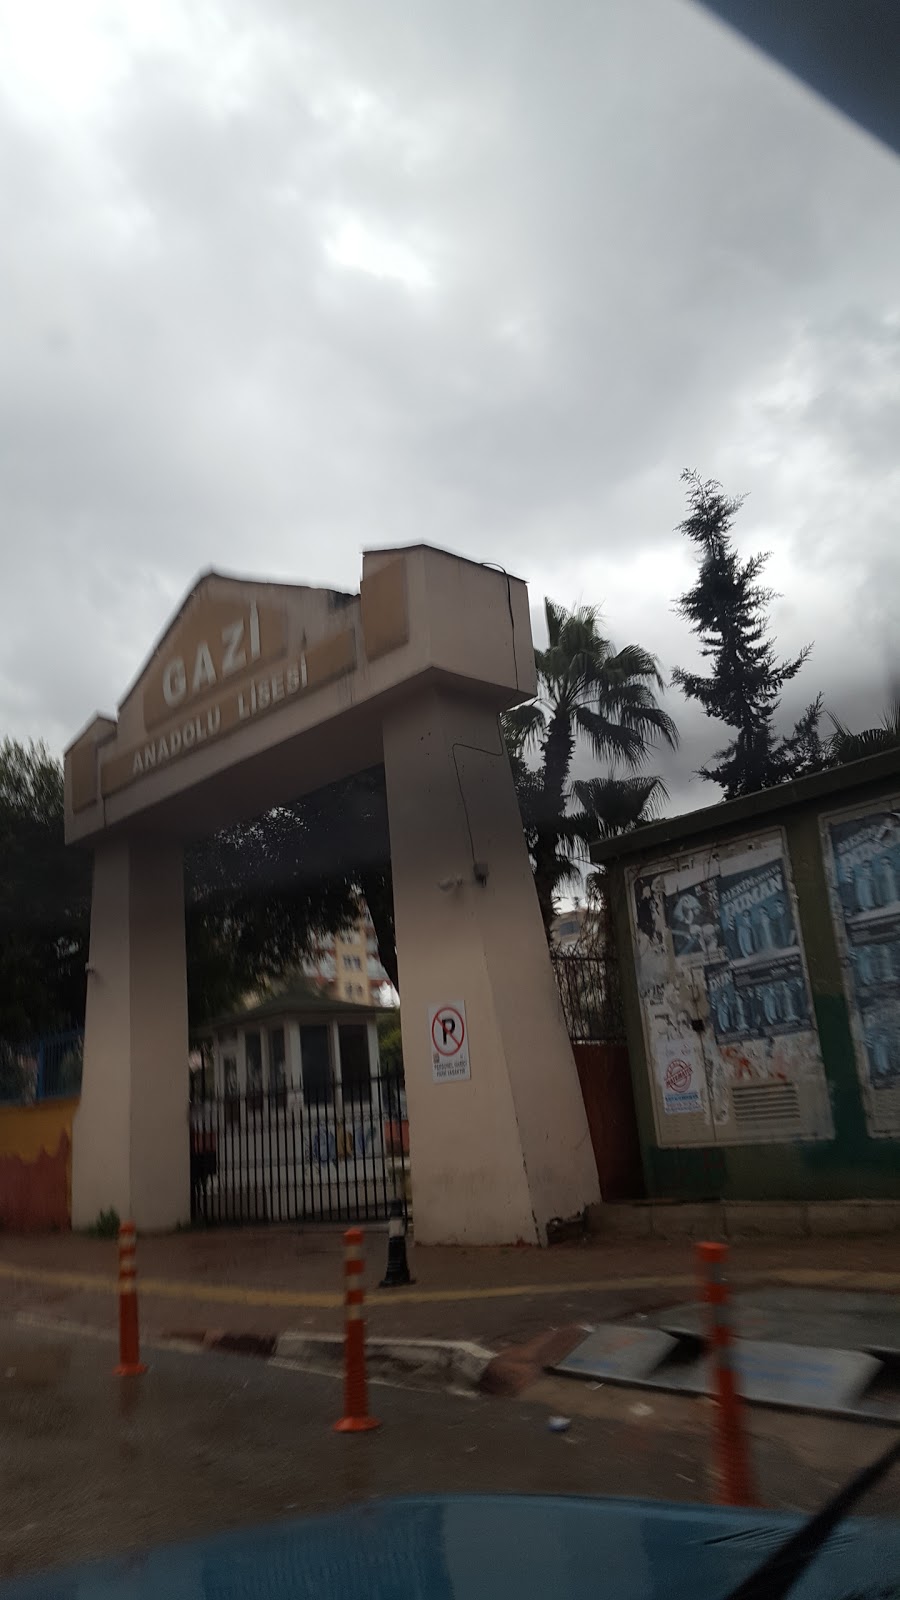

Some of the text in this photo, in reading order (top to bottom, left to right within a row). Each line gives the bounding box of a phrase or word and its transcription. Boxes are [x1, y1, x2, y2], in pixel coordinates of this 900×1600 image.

[162, 599, 261, 708] GAZİ
[132, 651, 308, 776] ANADOLU LİSESİ
[442, 1018, 455, 1045] P
